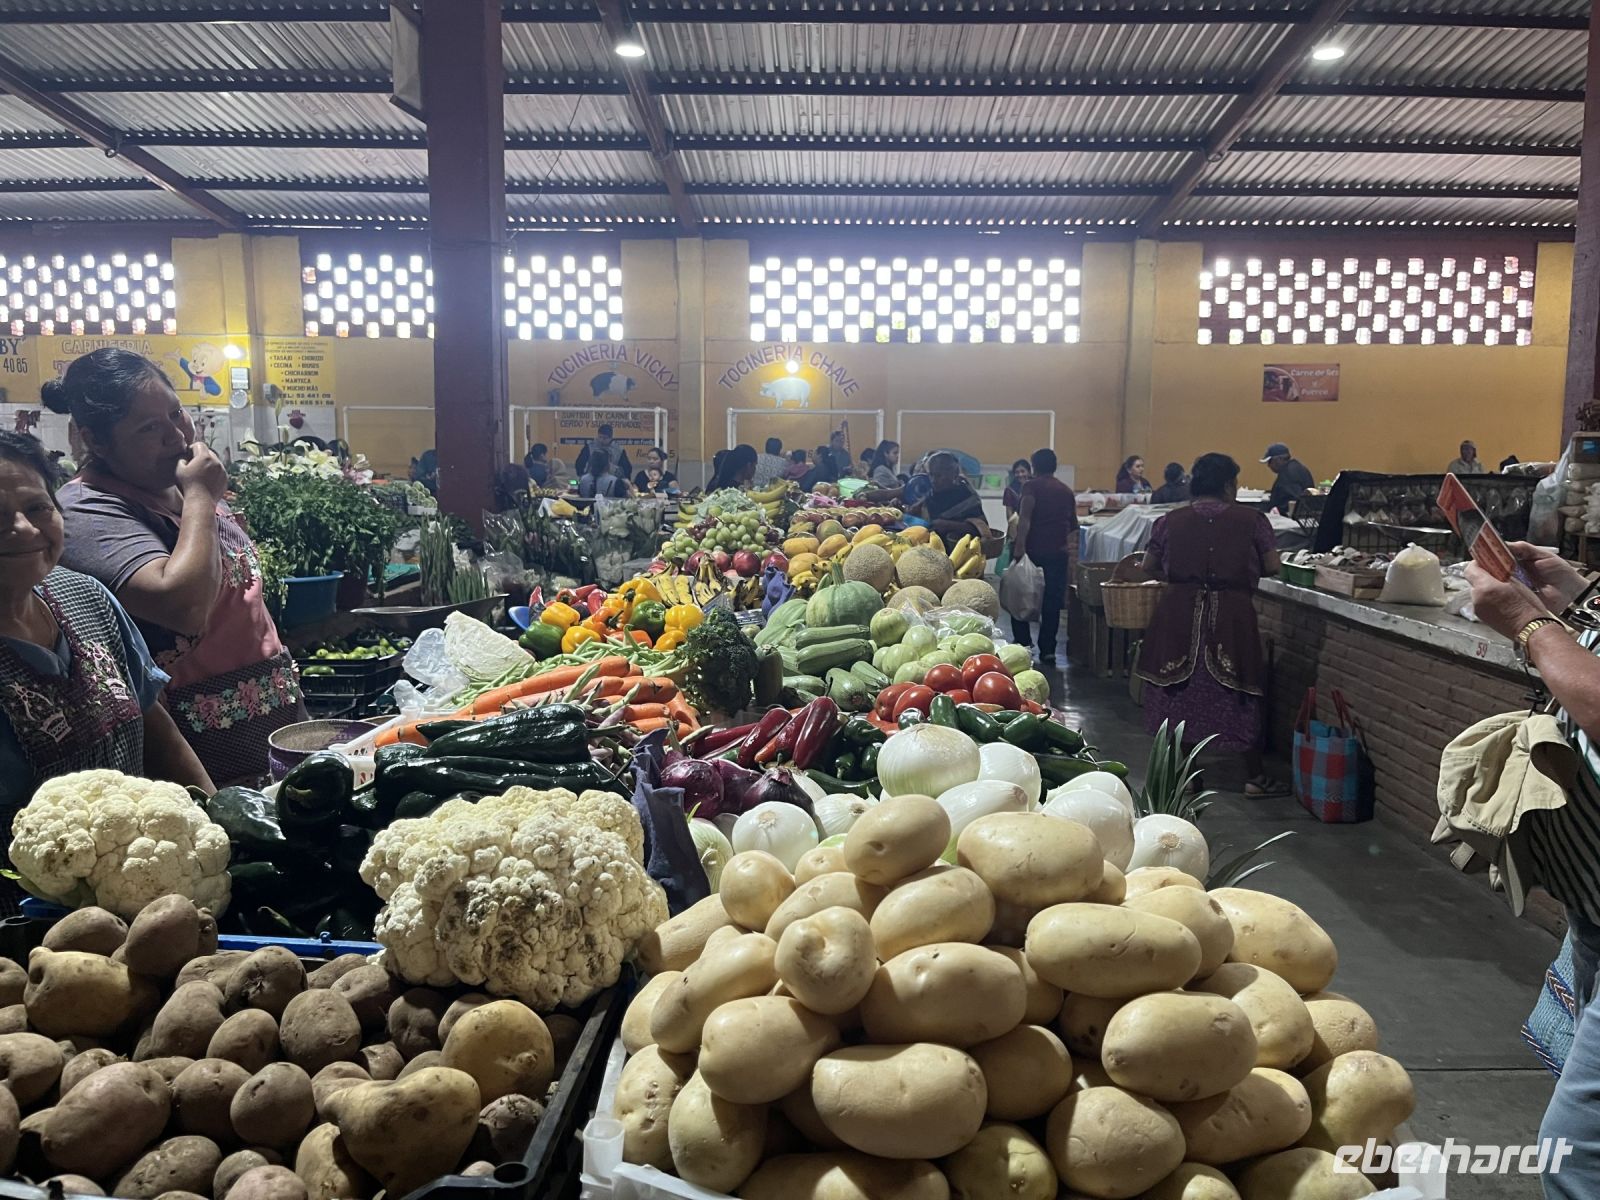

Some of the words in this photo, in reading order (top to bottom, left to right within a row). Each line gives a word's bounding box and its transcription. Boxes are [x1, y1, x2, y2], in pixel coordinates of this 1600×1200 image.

[547, 343, 628, 385] TOCINERIA
[636, 348, 679, 387] VICKY
[718, 344, 803, 389] TOCINERIA
[810, 352, 860, 397] CHAVE
